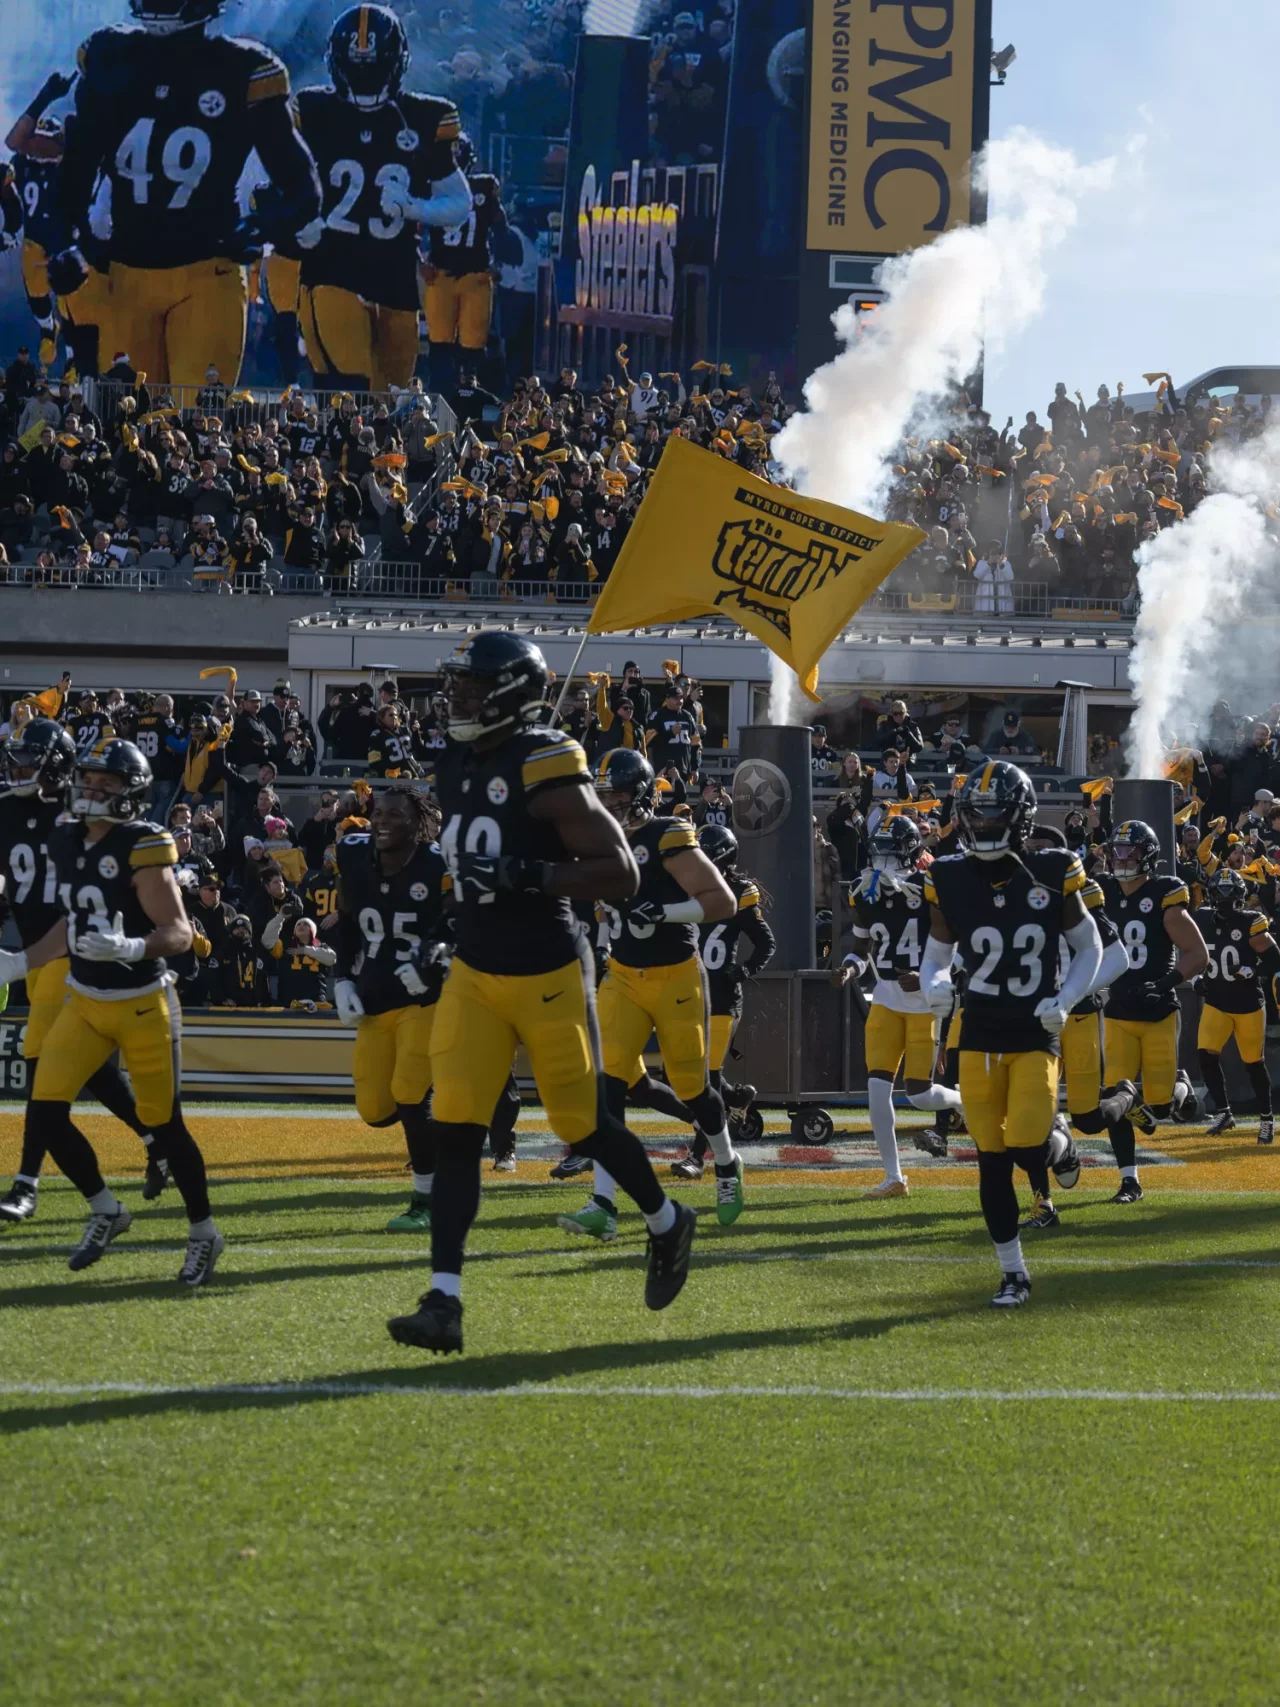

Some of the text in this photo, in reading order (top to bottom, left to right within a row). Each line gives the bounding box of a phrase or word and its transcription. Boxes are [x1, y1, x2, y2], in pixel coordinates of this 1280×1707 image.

[350, 32, 377, 49] 23
[115, 117, 212, 209] 49
[827, 102, 848, 226] MEDICINE
[326, 159, 411, 239] 23
[299, 436, 317, 454] 12
[744, 492, 787, 518] MYRON
[789, 511, 826, 532] COPE'S
[754, 517, 783, 540] The
[77, 725, 100, 748] 22
[136, 731, 158, 758] 58
[973, 778, 999, 793] 23
[358, 907, 421, 961] 95
[870, 918, 922, 969] 24
[969, 923, 1047, 997] 23
